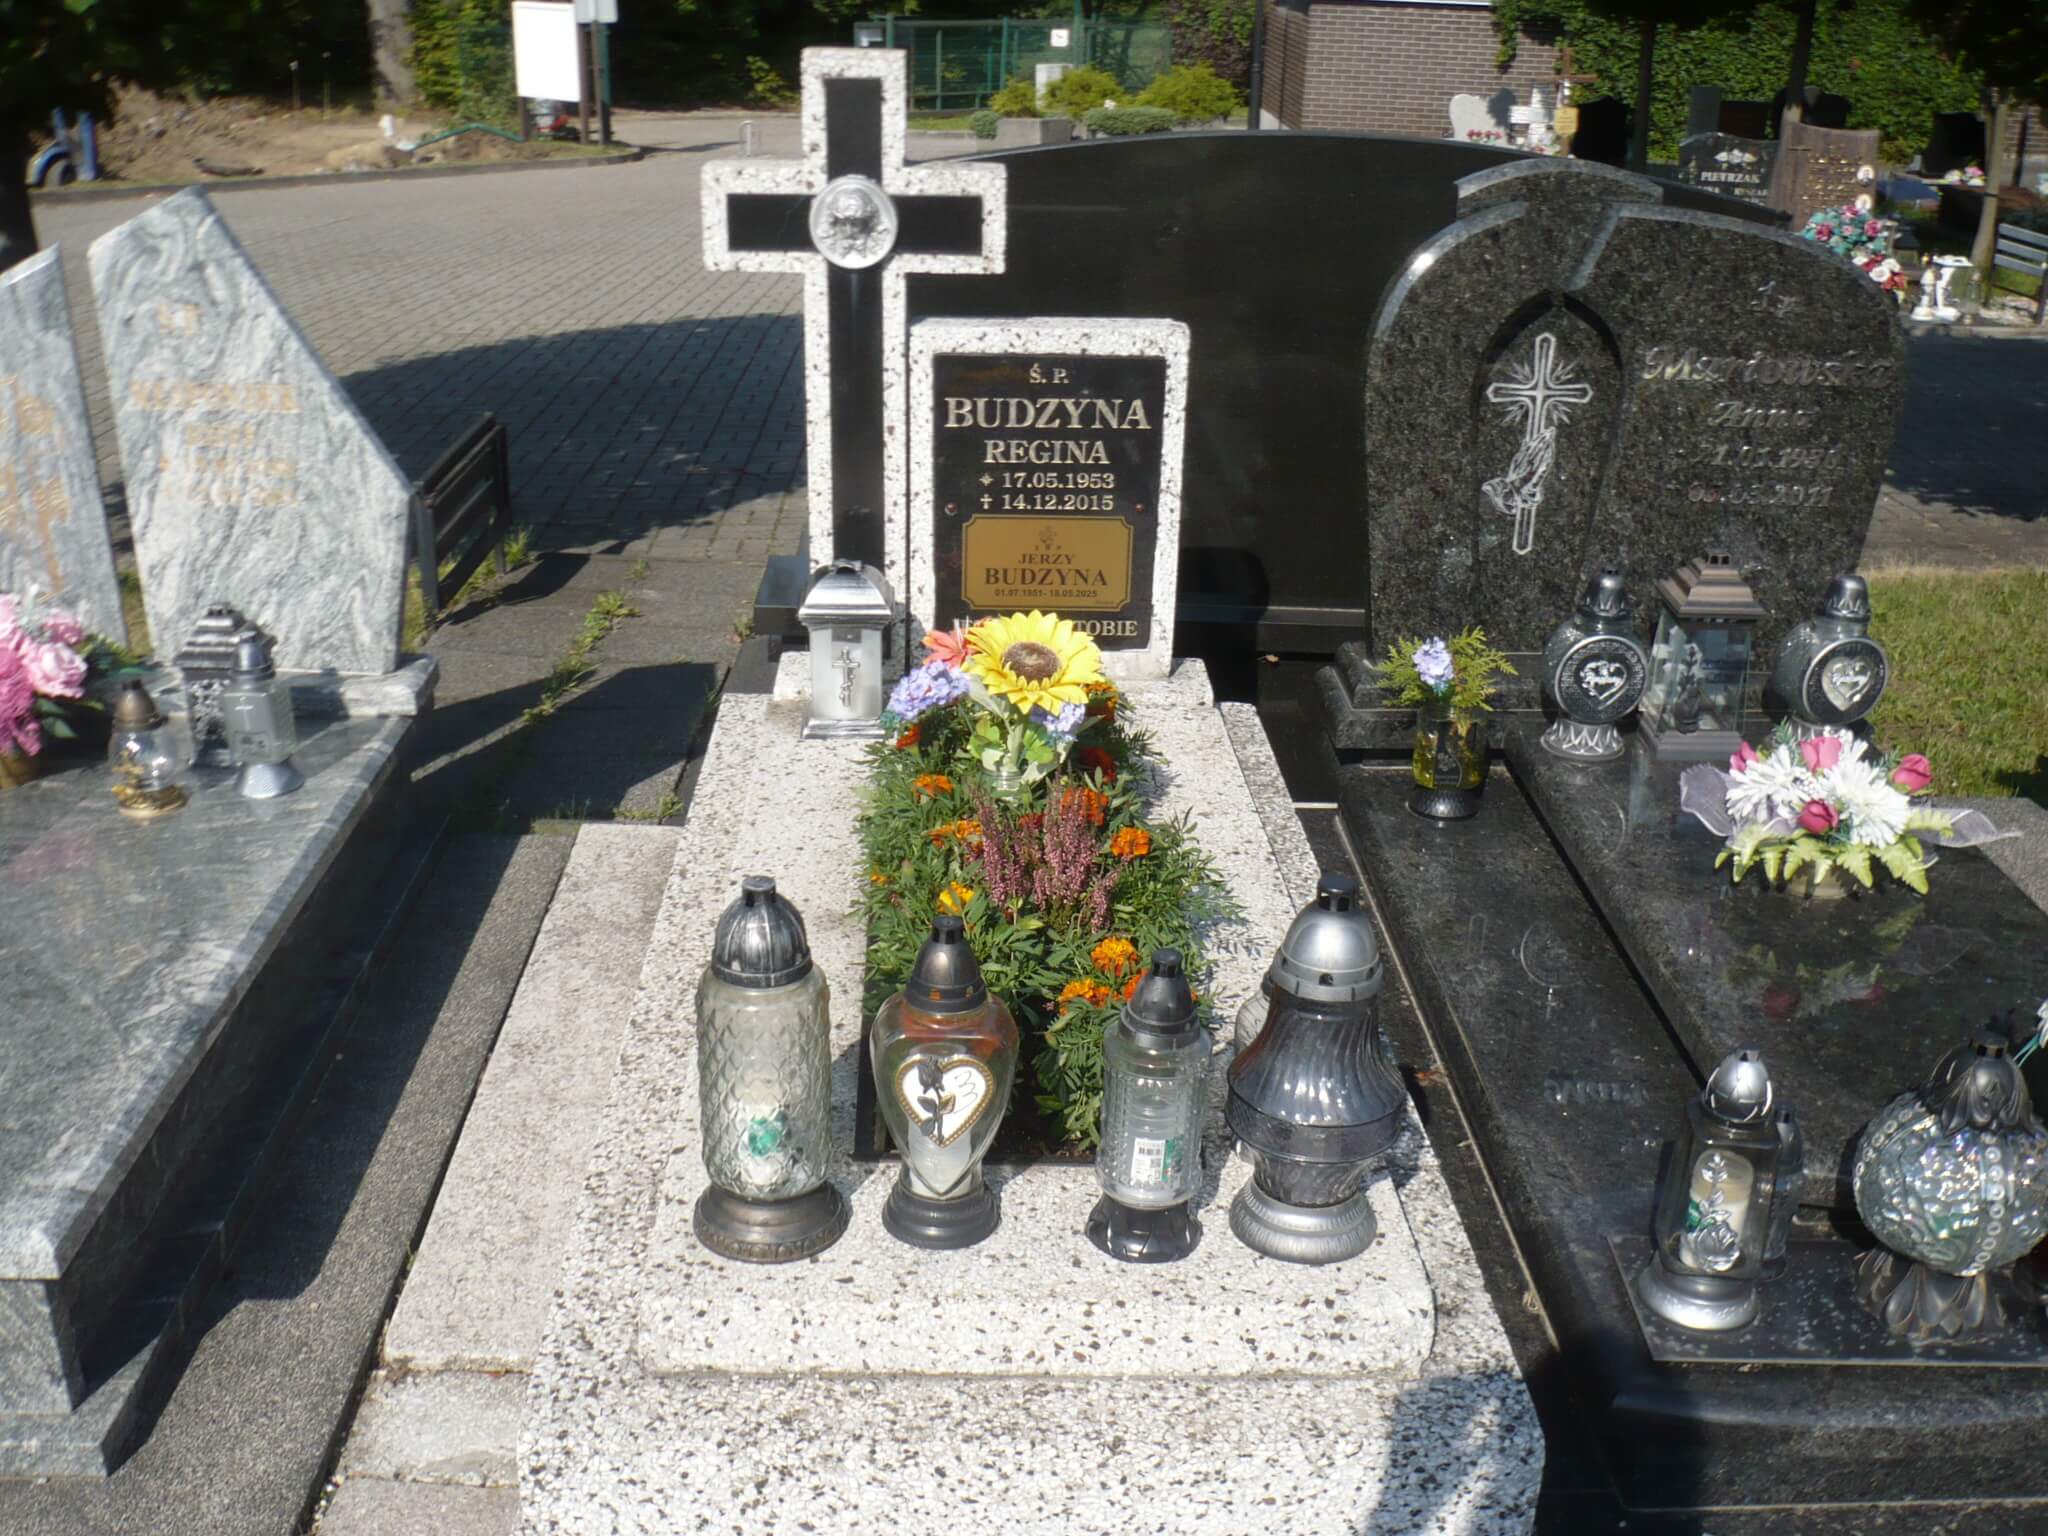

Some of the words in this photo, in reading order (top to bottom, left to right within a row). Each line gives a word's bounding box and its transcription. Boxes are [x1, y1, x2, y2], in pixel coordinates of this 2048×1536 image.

[1052, 368, 1070, 384] P.
[944, 397, 1152, 430] BUDZYNA
[984, 439, 1111, 464] REGINA
[1002, 472, 1115, 489] 17.05.1953
[1002, 494, 1114, 511] 14.12.2015
[1018, 553, 1074, 565] JERZY
[985, 567, 1108, 586] BUDZYNA
[1072, 620, 1138, 636] TOBIE
